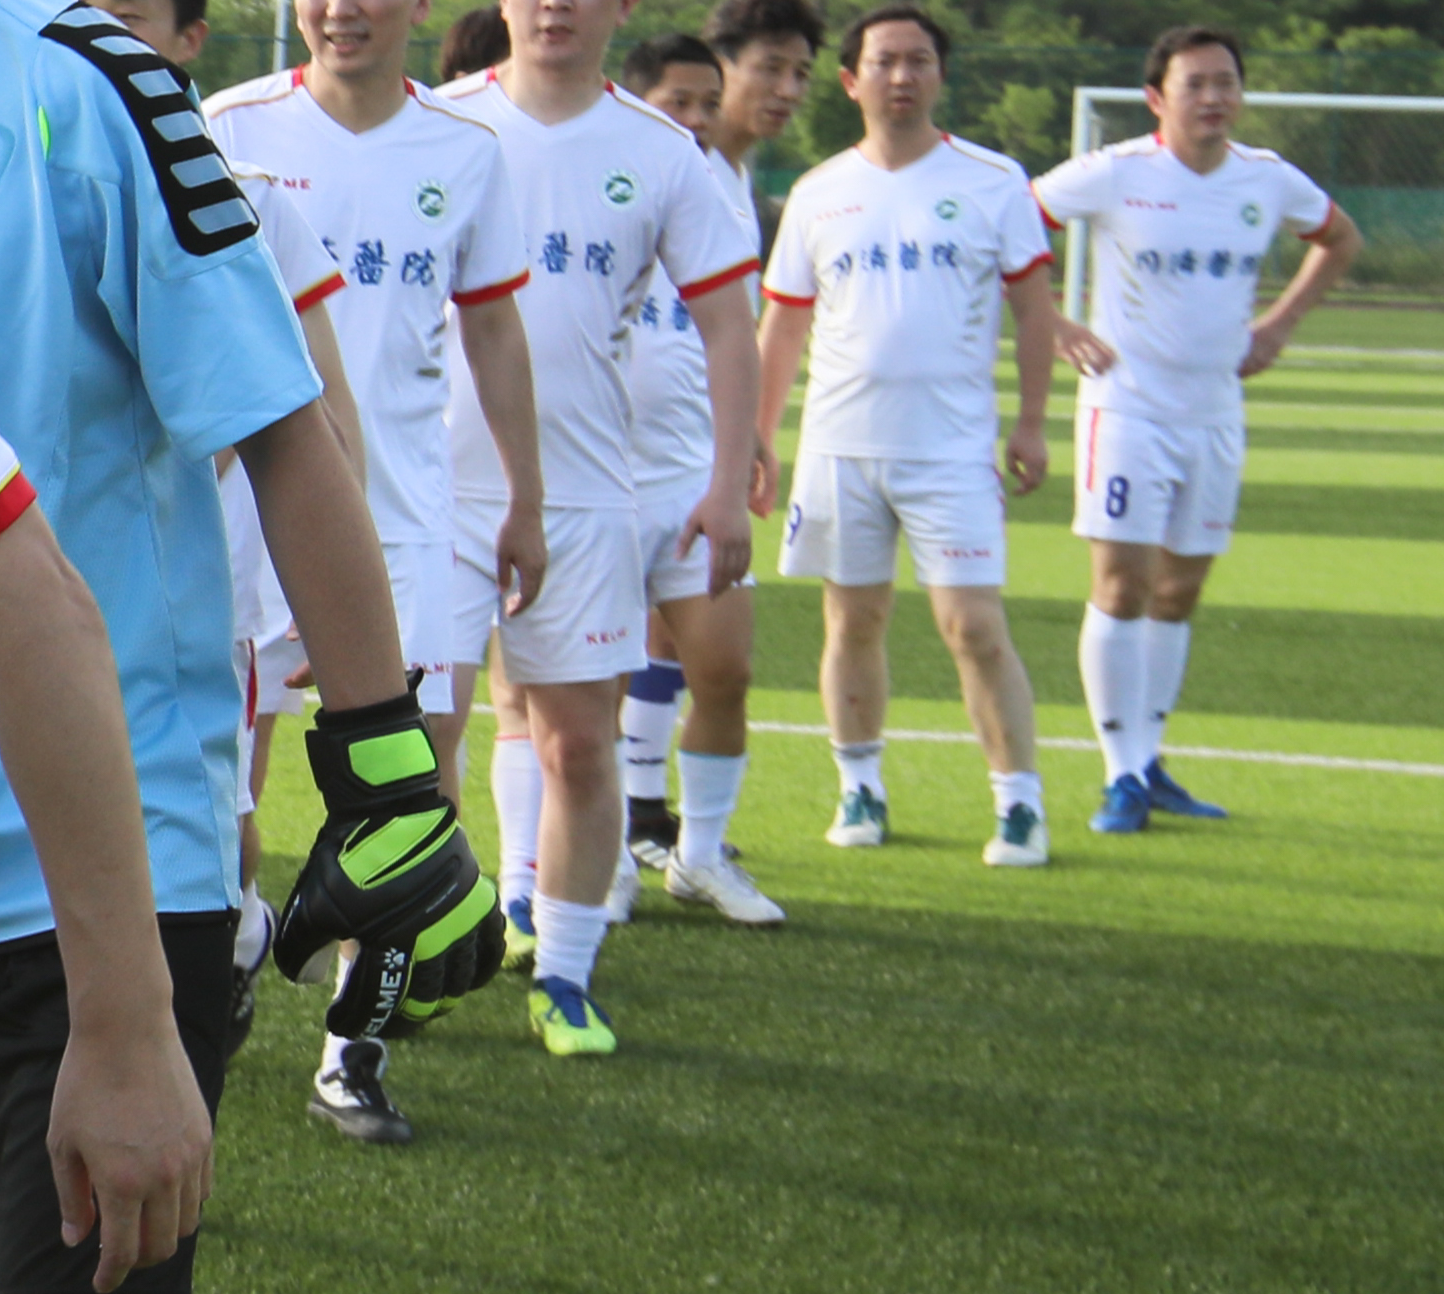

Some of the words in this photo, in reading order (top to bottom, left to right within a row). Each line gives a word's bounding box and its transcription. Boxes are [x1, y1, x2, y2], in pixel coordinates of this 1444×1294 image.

[538, 229, 616, 277] 醫院
[1105, 475, 1131, 520] 8
[361, 970, 403, 1039] ELME
